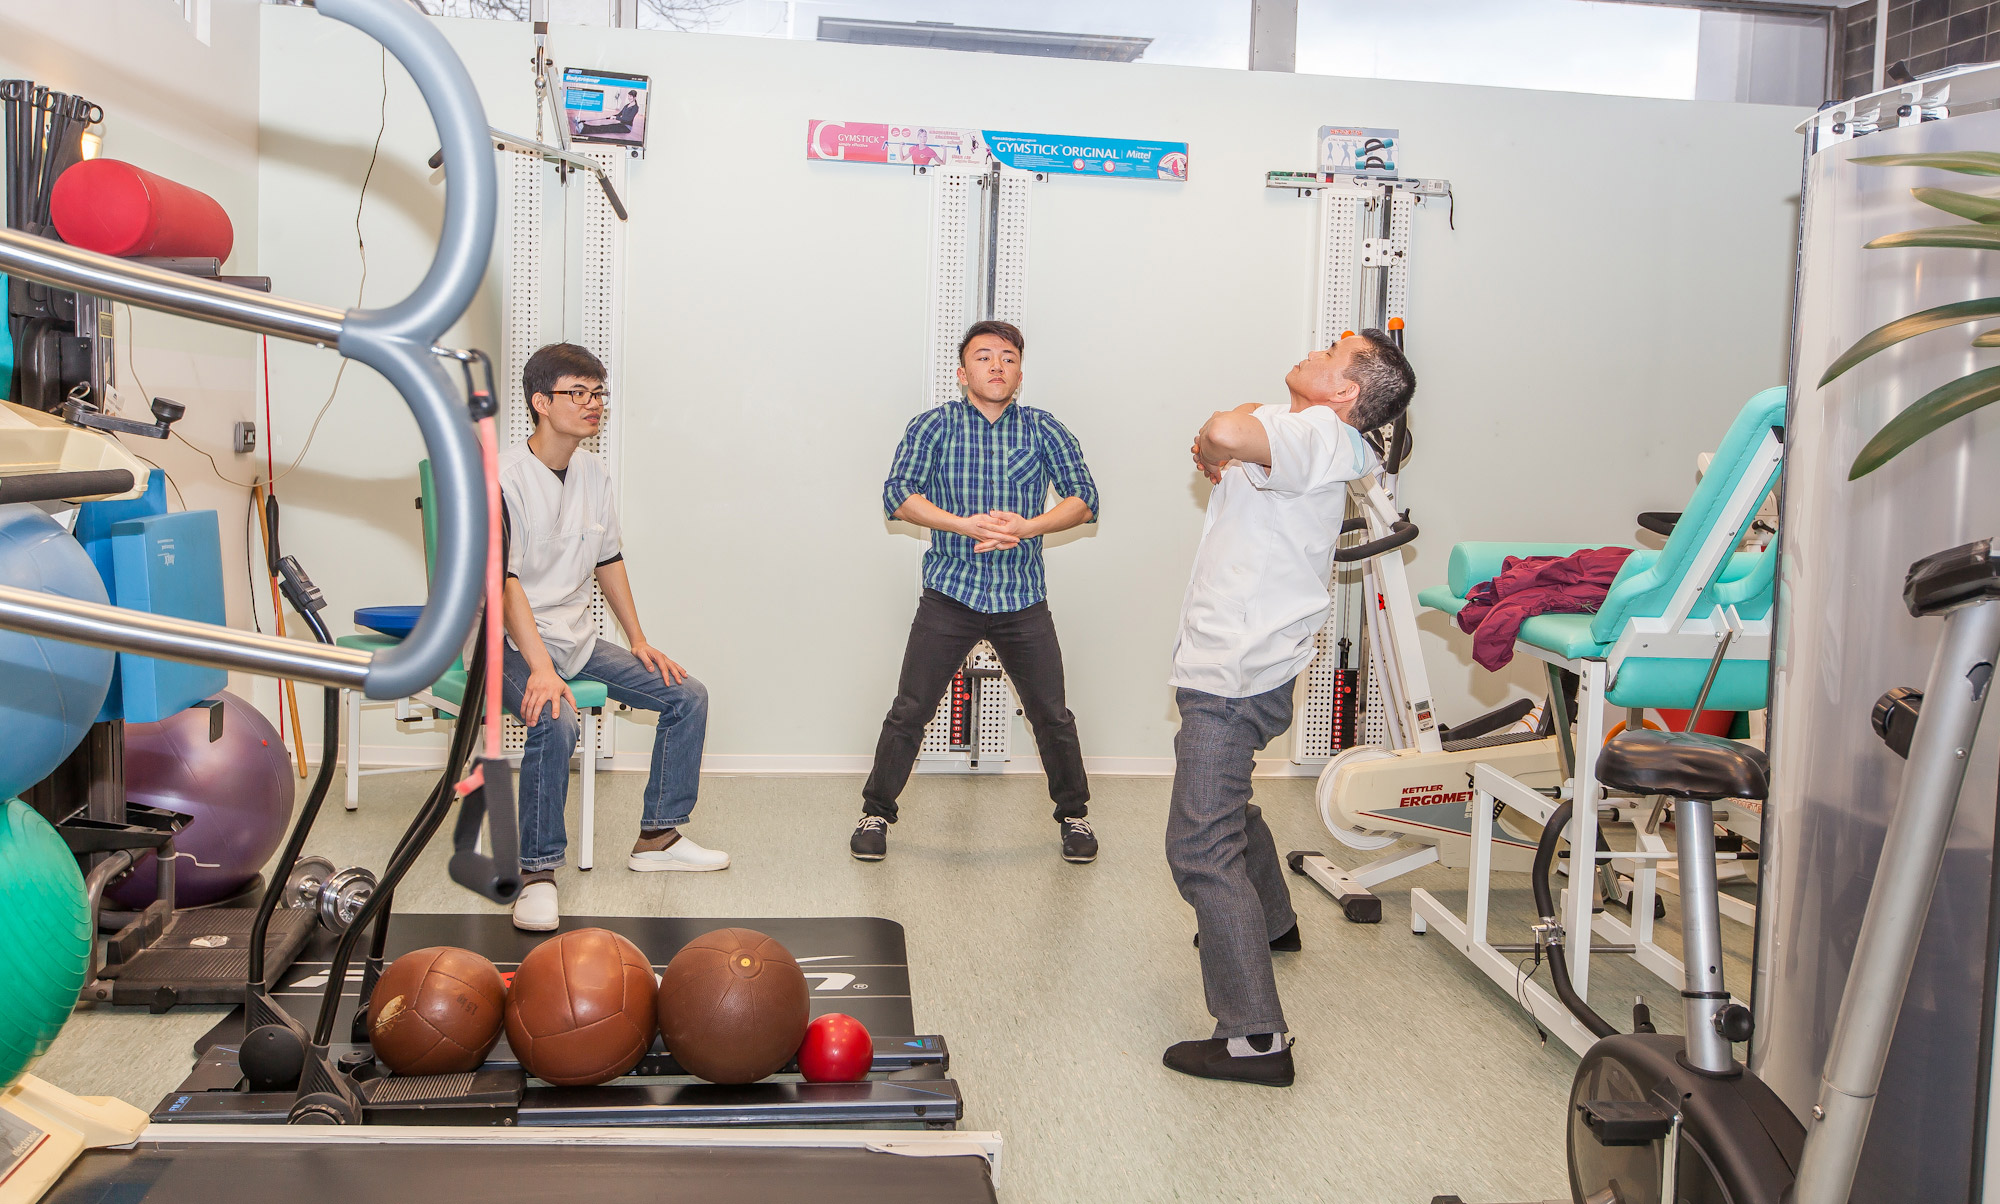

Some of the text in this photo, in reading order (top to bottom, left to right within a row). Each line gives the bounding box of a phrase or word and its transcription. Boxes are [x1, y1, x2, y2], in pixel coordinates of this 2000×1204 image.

[838, 133, 879, 144] GYMSTICK
[996, 142, 1152, 160] GYMSTICK ORIGINAL Mittel
[1402, 785, 1443, 794] KETTLER
[12, 1130, 40, 1157] electronic
